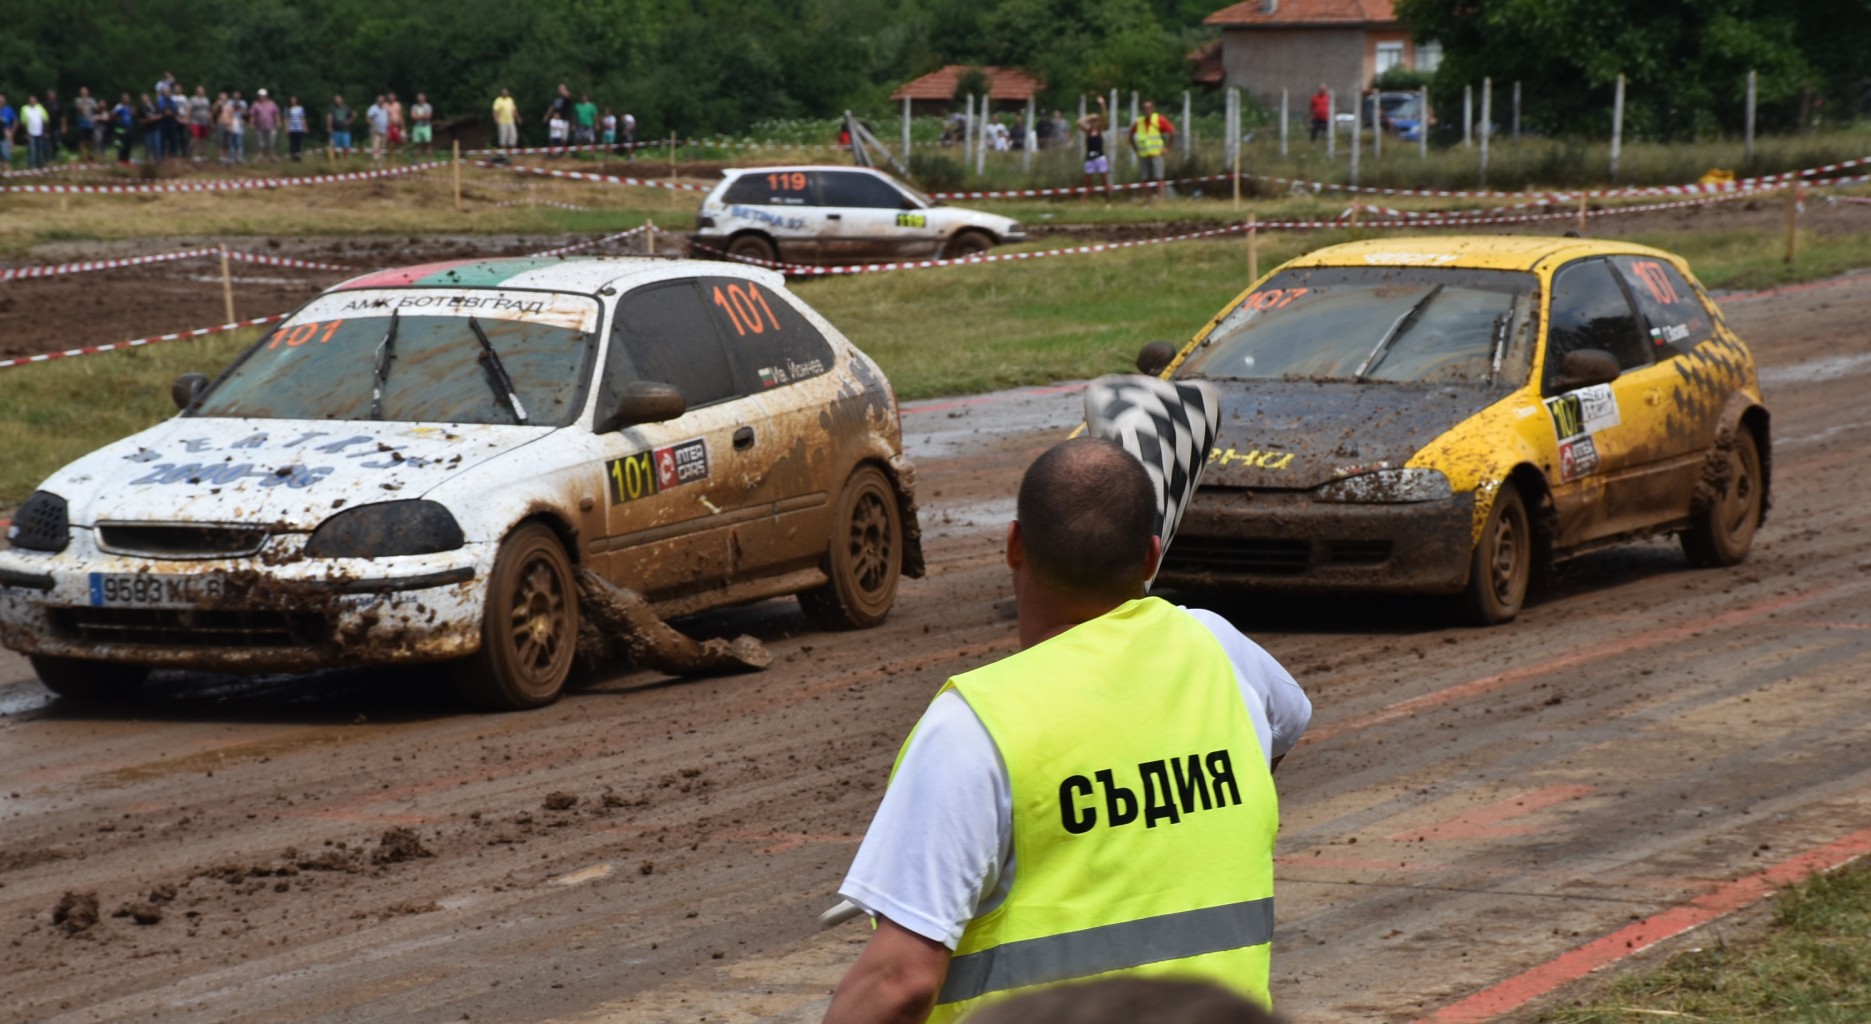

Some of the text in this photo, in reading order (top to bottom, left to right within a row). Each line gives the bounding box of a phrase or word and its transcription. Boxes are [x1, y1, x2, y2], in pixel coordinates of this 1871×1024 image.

[766, 172, 807, 191] 119
[898, 214, 925, 228] 119
[1632, 260, 1680, 305] 107
[341, 296, 544, 315] АМК БОТЕВГРАД
[713, 281, 781, 336] 101
[1242, 287, 1310, 311] 107
[267, 318, 344, 350] 101
[674, 443, 704, 466] INTER
[611, 451, 655, 503] 101
[677, 459, 706, 481] CARS
[1058, 749, 1243, 835] СЪДИЯ
